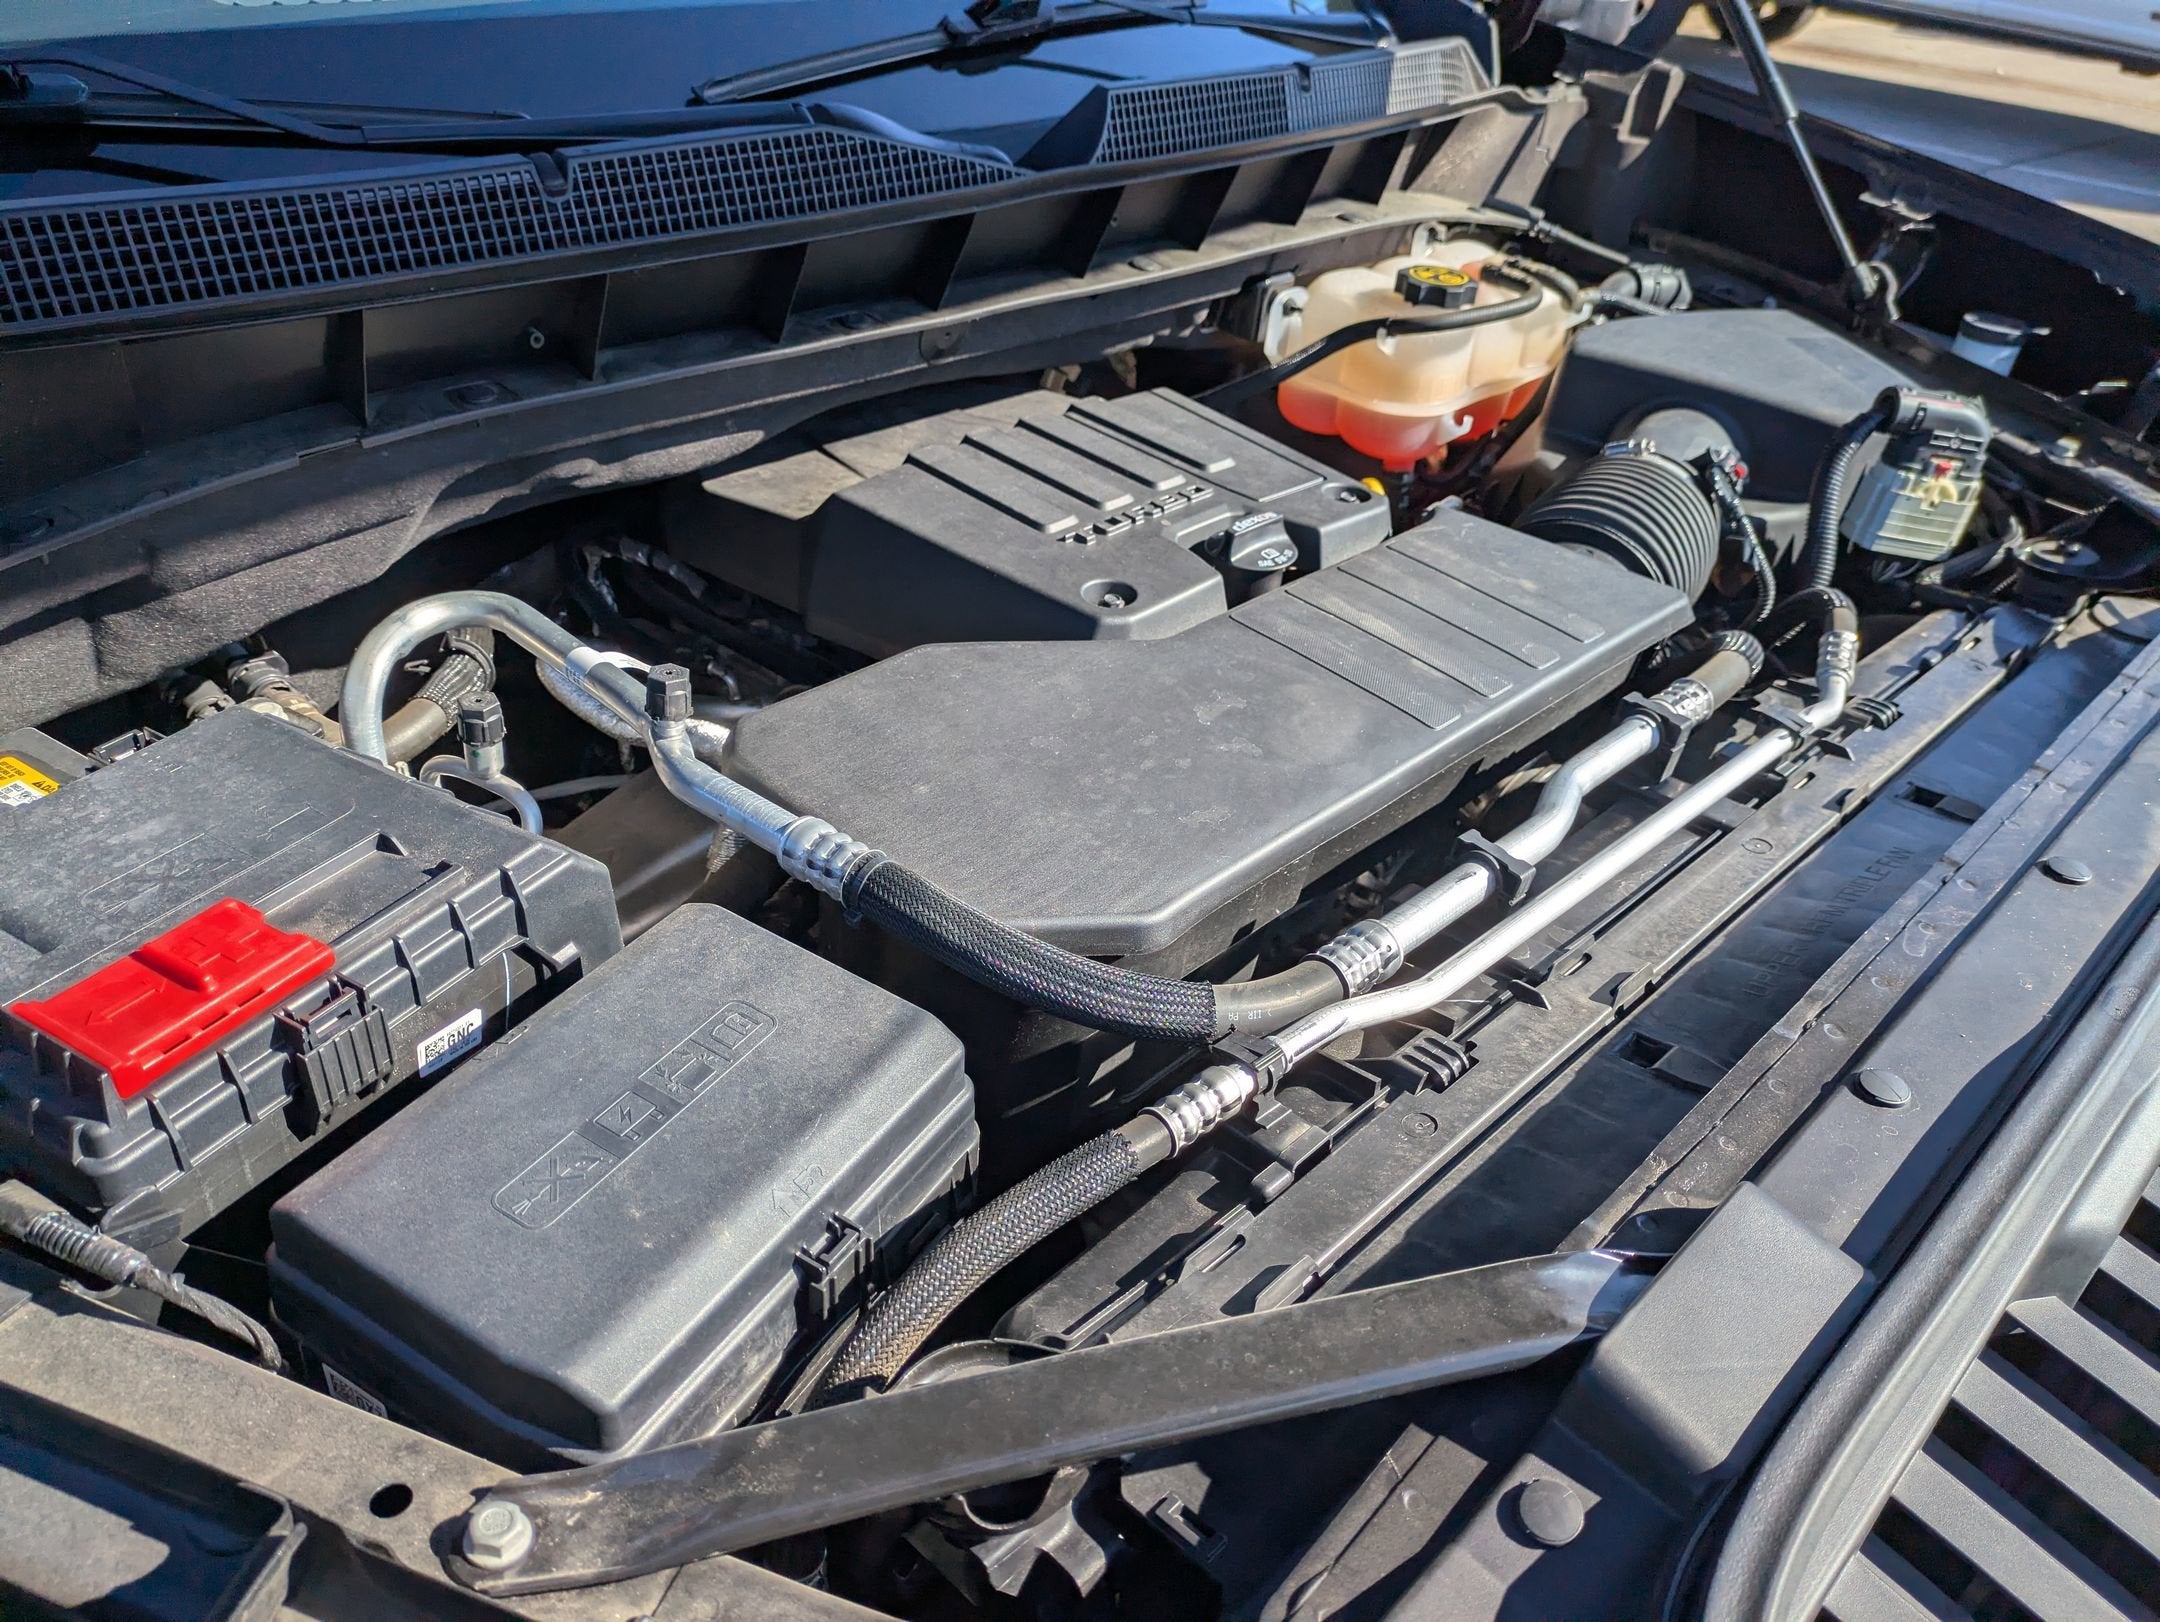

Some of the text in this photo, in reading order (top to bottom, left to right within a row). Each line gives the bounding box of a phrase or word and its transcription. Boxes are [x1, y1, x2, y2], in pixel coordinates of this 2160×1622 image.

[1062, 484, 1215, 546] TURBO
[1232, 511, 1278, 532] dexos
[447, 1022, 474, 1049] GNC
